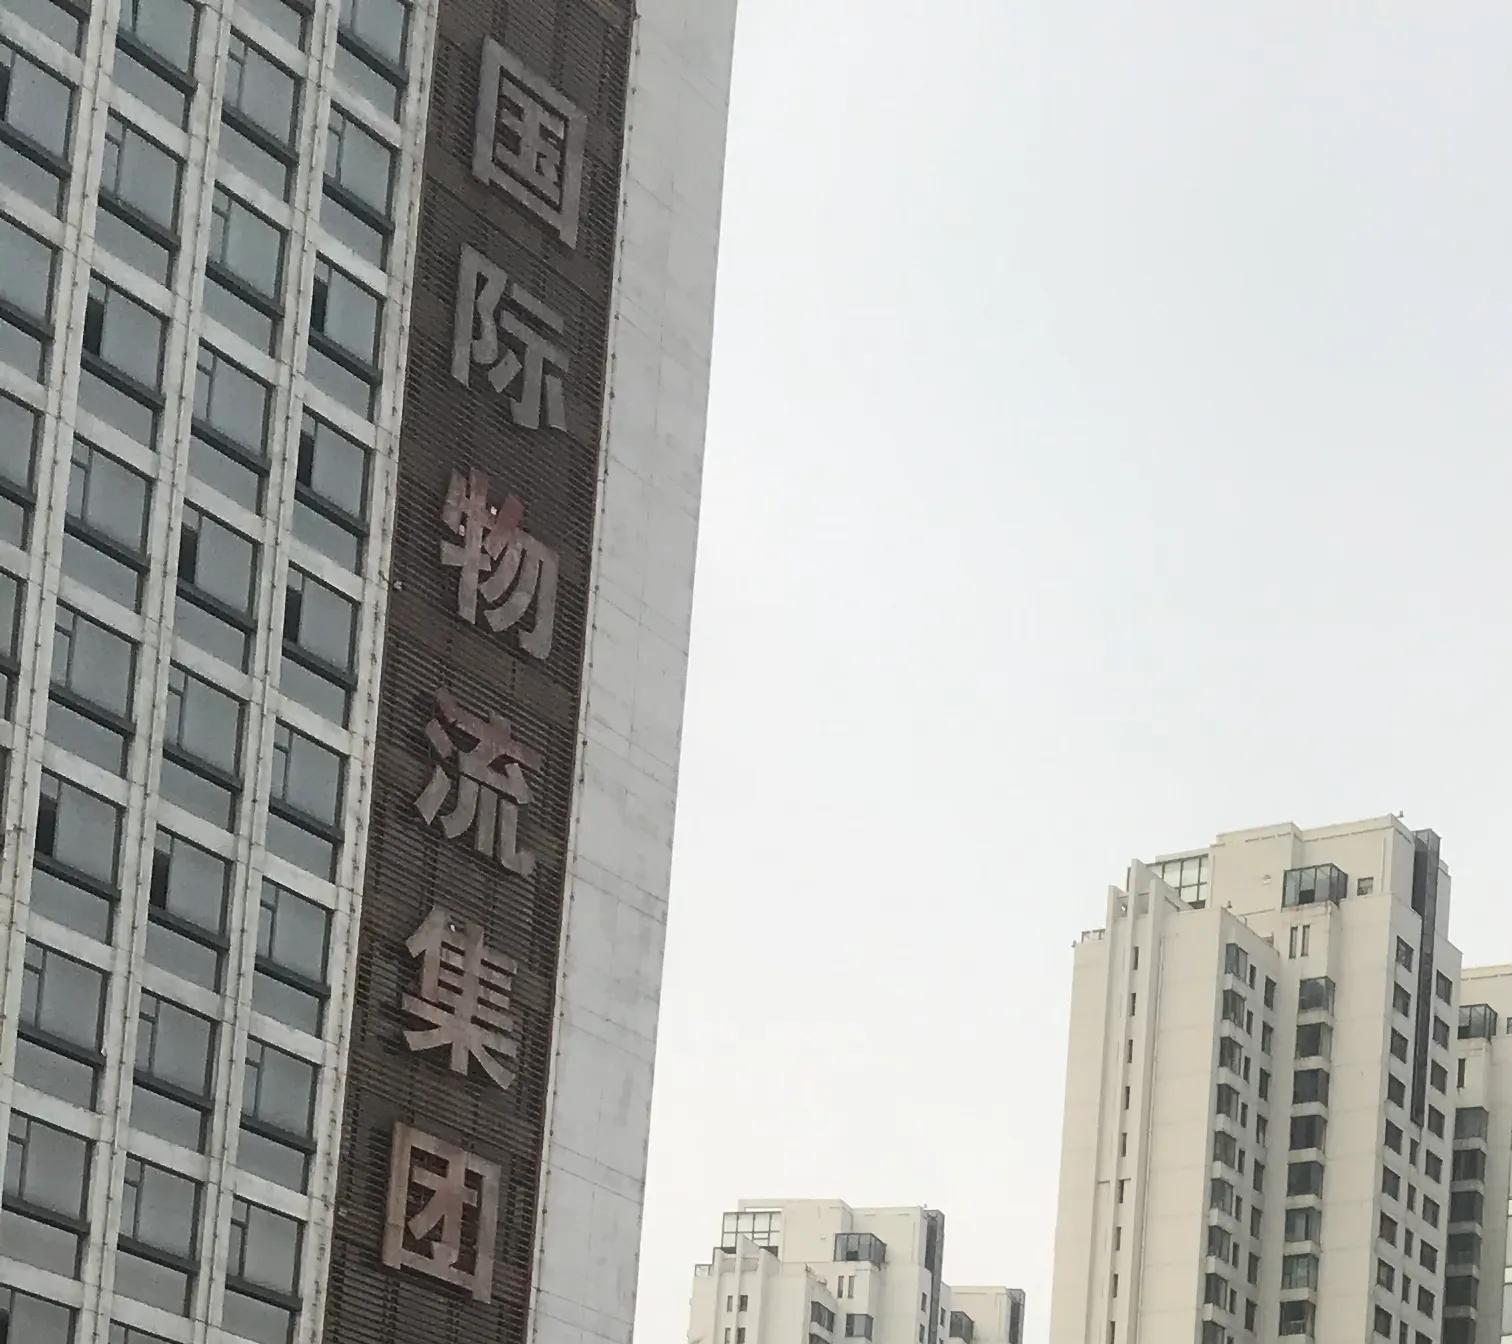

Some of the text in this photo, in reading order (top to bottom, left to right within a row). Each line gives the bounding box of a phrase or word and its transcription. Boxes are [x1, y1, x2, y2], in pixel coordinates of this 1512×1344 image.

[380, 34, 588, 1305] 国际物流集团
